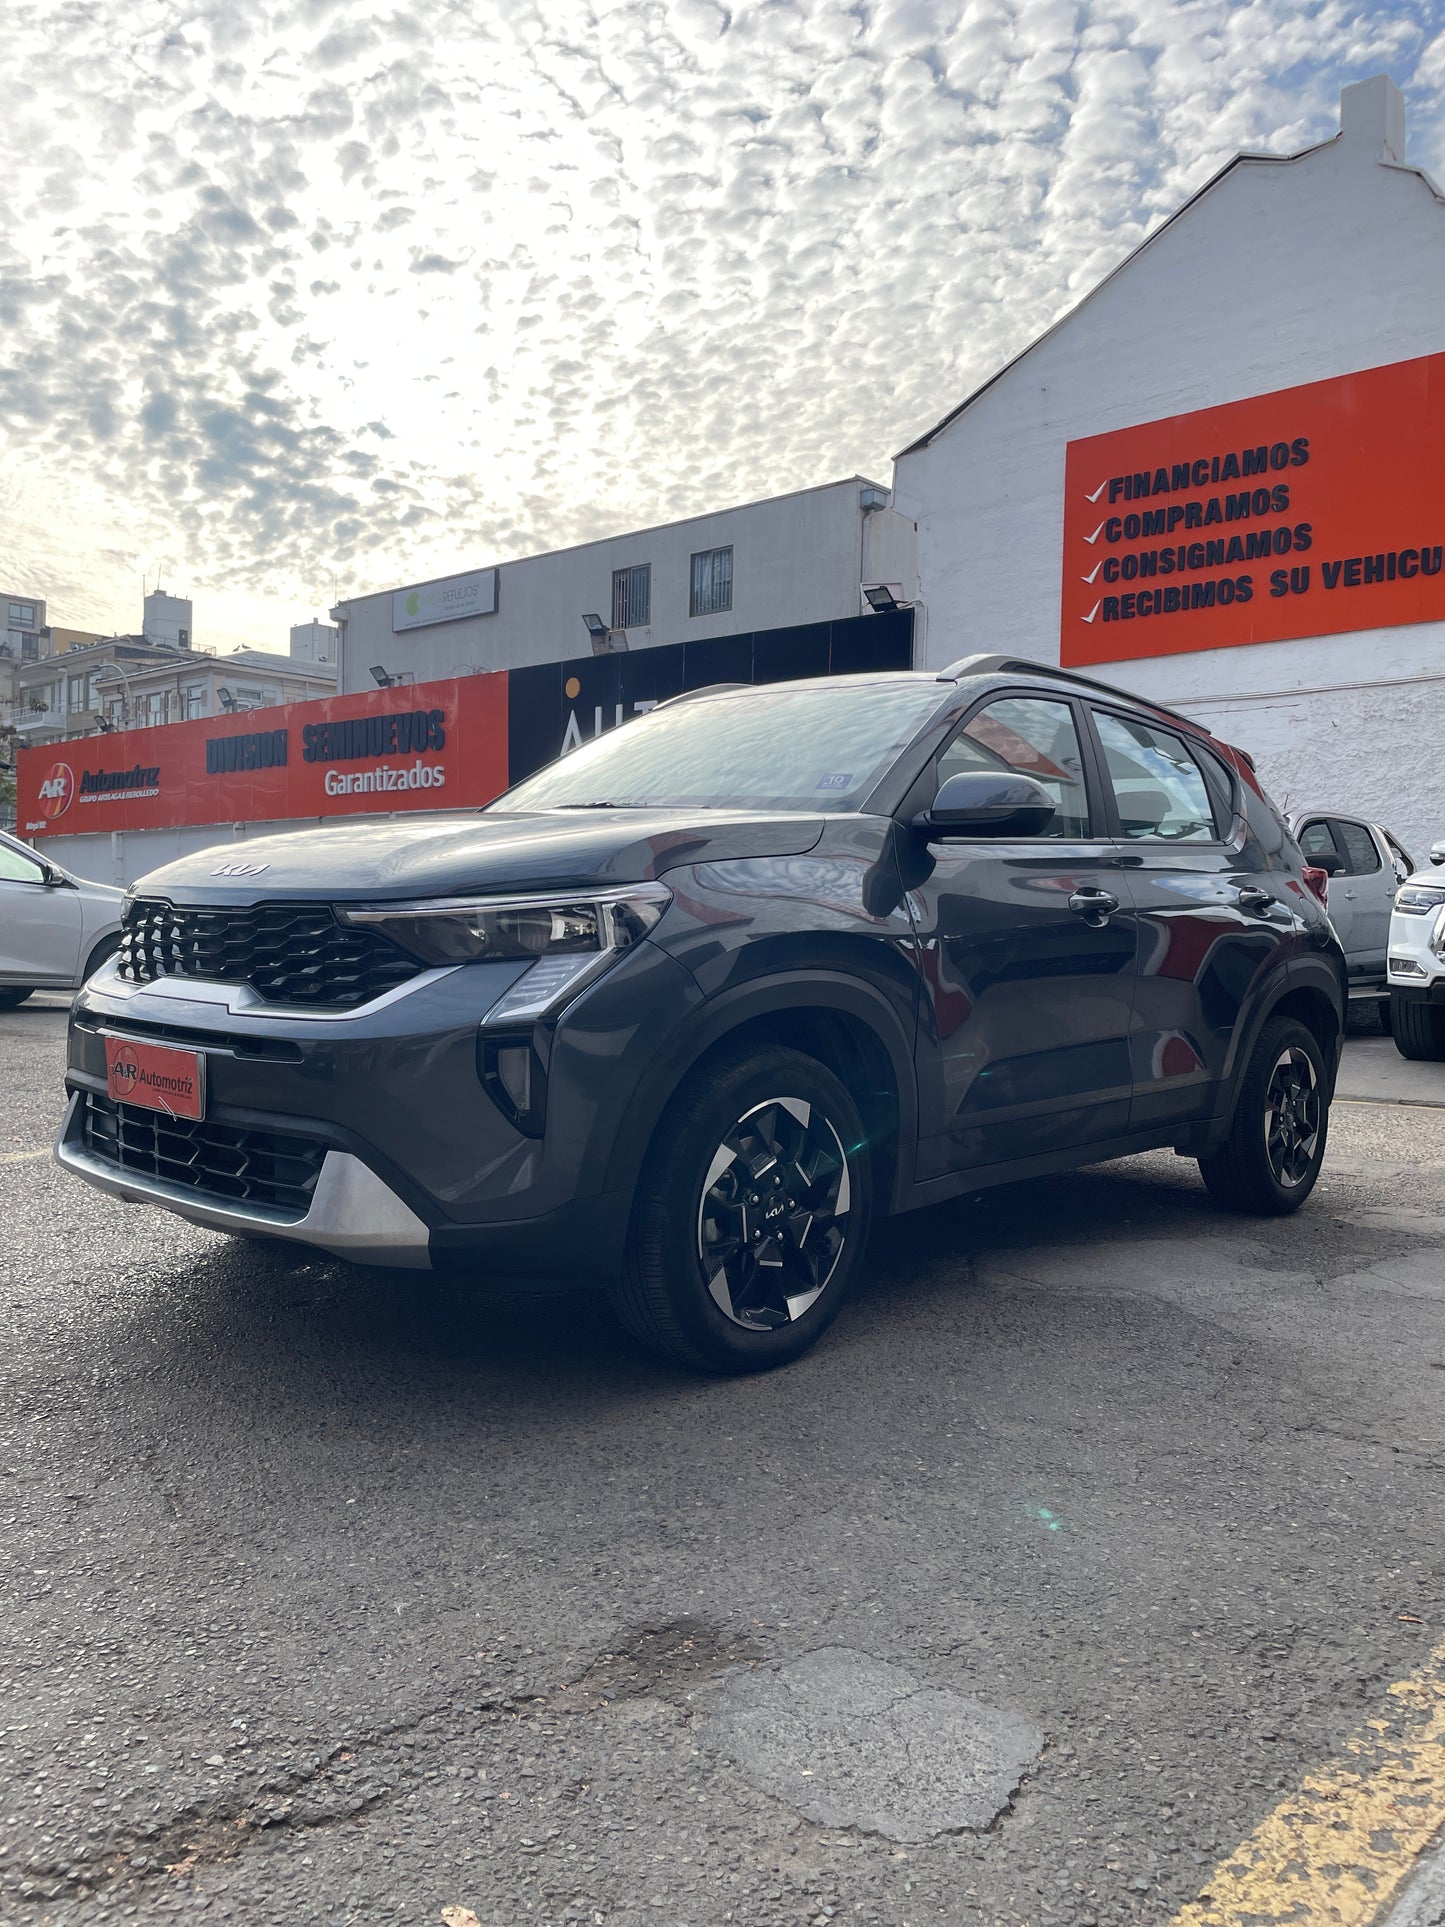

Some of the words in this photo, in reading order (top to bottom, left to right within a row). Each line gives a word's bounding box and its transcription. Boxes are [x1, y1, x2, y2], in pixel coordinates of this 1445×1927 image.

[1108, 438, 1310, 503] FINANCIAMOS
[1105, 484, 1290, 543] COMPRAMOS
[1103, 523, 1313, 583] CONSIGNAMOS
[1102, 575, 1253, 622] RECIBIMOS
[1270, 566, 1310, 598] SU
[206, 728, 288, 774] DIVISION
[303, 709, 445, 763] SEMINUEVOS
[79, 764, 160, 794] Automotriz
[324, 760, 445, 796] Garantizados
[209, 863, 271, 877] KIA
[139, 1068, 193, 1095] Automotriz
